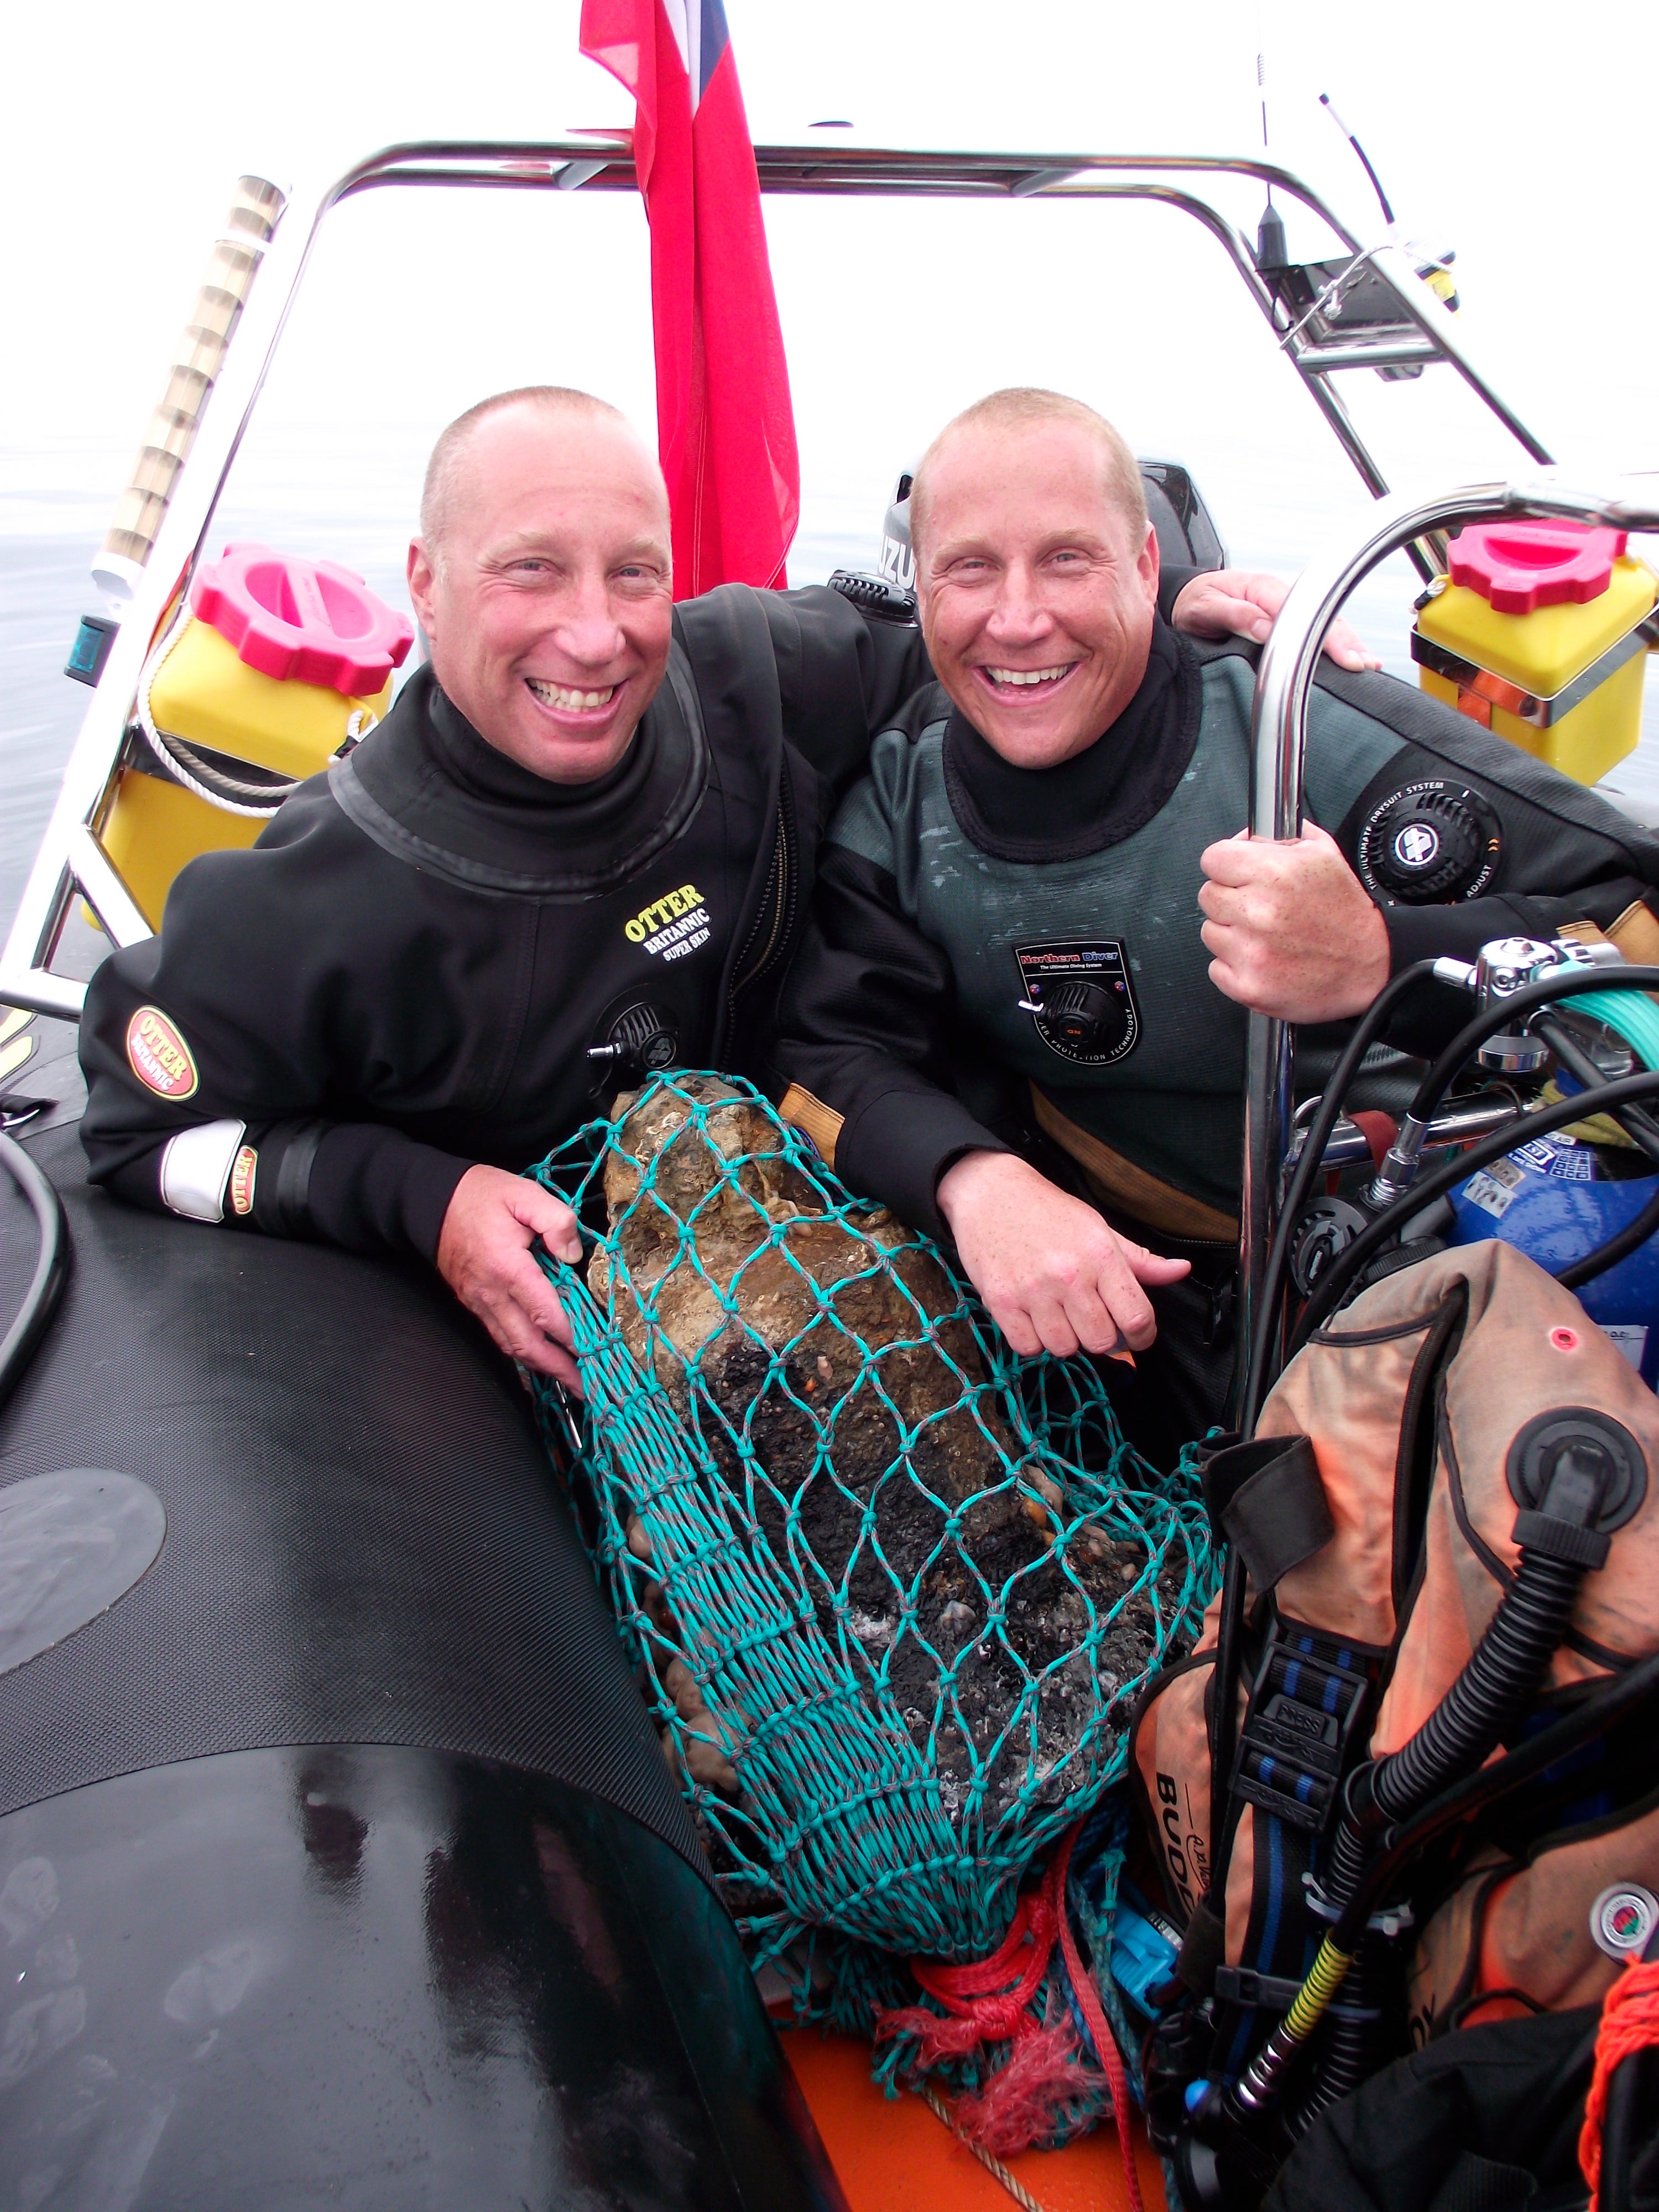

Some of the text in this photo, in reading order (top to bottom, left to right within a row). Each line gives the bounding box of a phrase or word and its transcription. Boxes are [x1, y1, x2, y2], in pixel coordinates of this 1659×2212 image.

[1360, 782, 1444, 891] THE ULTIMATE DRYSUIT SYSTEM
[1466, 864, 1492, 898] ADJUST
[625, 885, 705, 942] OTTER
[643, 908, 710, 954] BRITANNIC
[663, 927, 711, 961] SUPER SKIN
[1020, 952, 1118, 964] Northern Diver
[140, 1015, 187, 1081] OTTER
[1110, 1009, 1133, 1056] TECHNOLOGY
[234, 1155, 253, 1209] OTTER
[1281, 1705, 1321, 1733] PRESS
